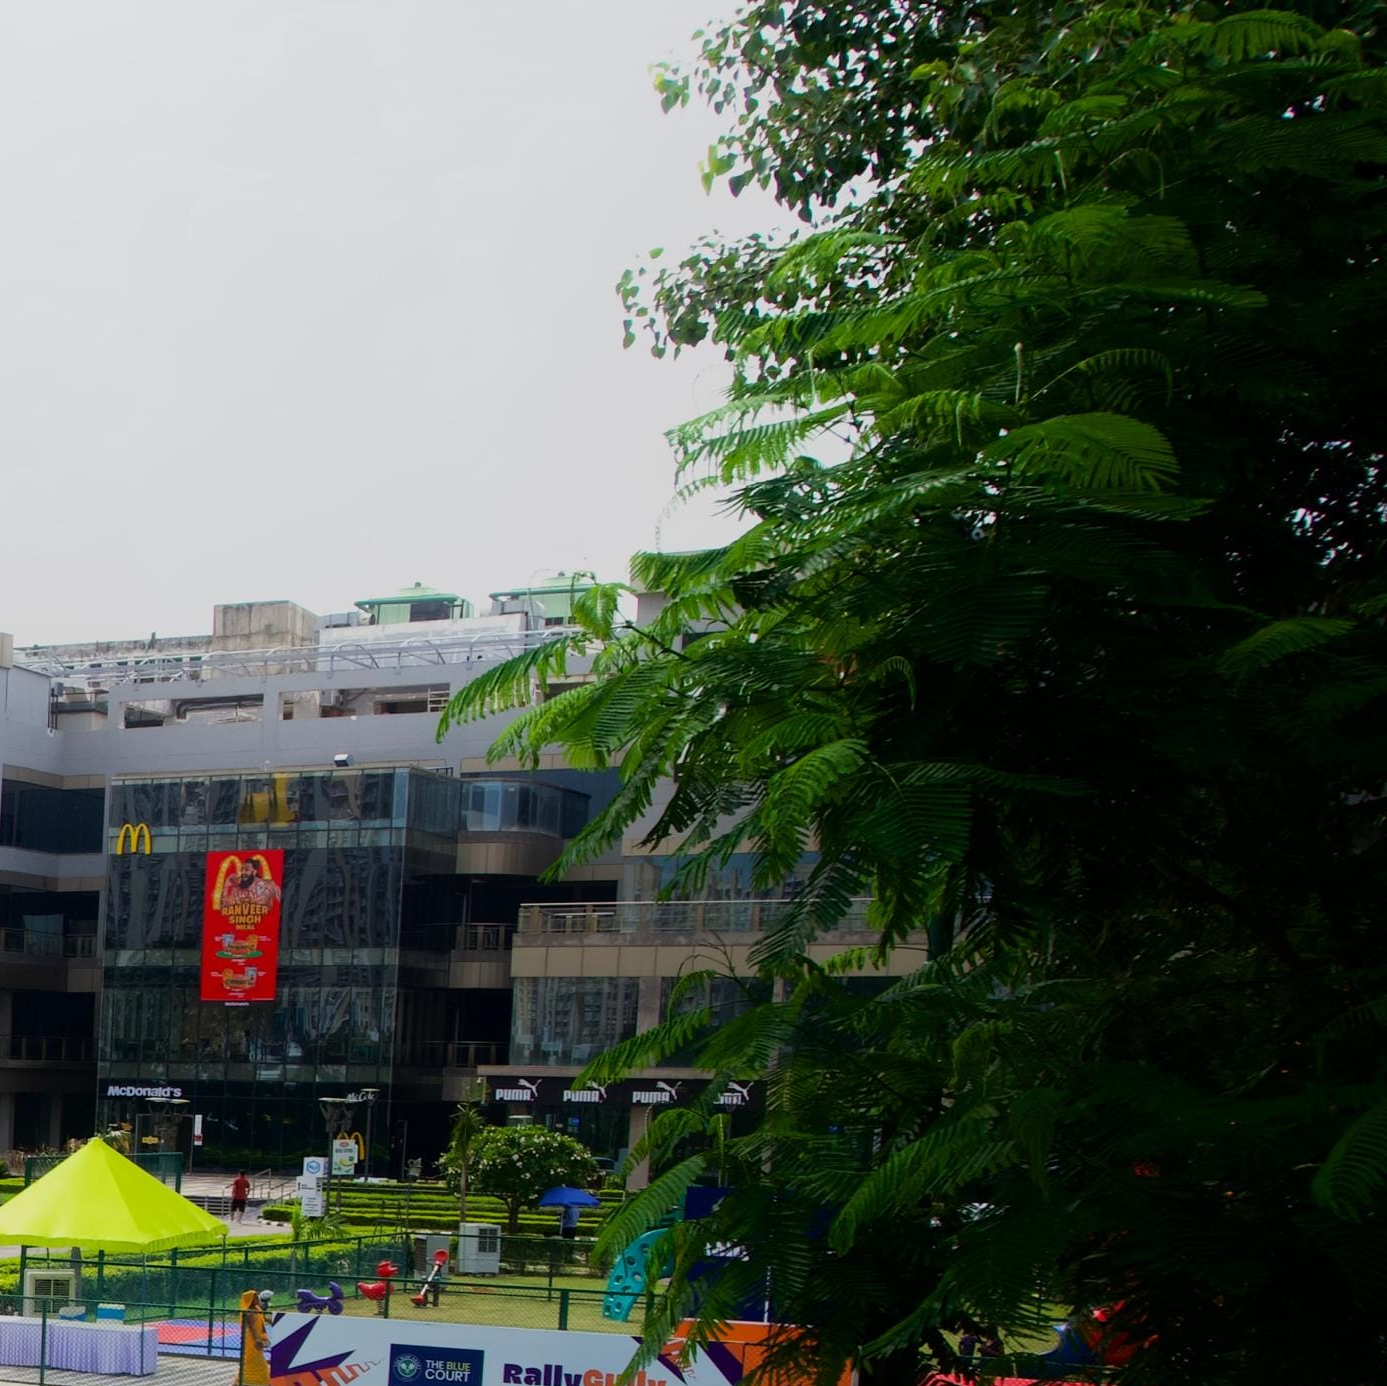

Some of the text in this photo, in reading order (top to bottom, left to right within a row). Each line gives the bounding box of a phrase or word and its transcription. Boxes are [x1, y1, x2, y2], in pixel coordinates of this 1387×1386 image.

[221, 903, 268, 916] RANVEER
[228, 915, 261, 924] SINGH
[107, 1085, 182, 1098] McDonald's
[495, 1088, 531, 1101] PUMA
[563, 1089, 599, 1102] PUMA
[632, 1091, 669, 1104] PUMA
[425, 1360, 444, 1369] THE
[446, 1361, 471, 1371] BLUE
[425, 1369, 471, 1382] COURT
